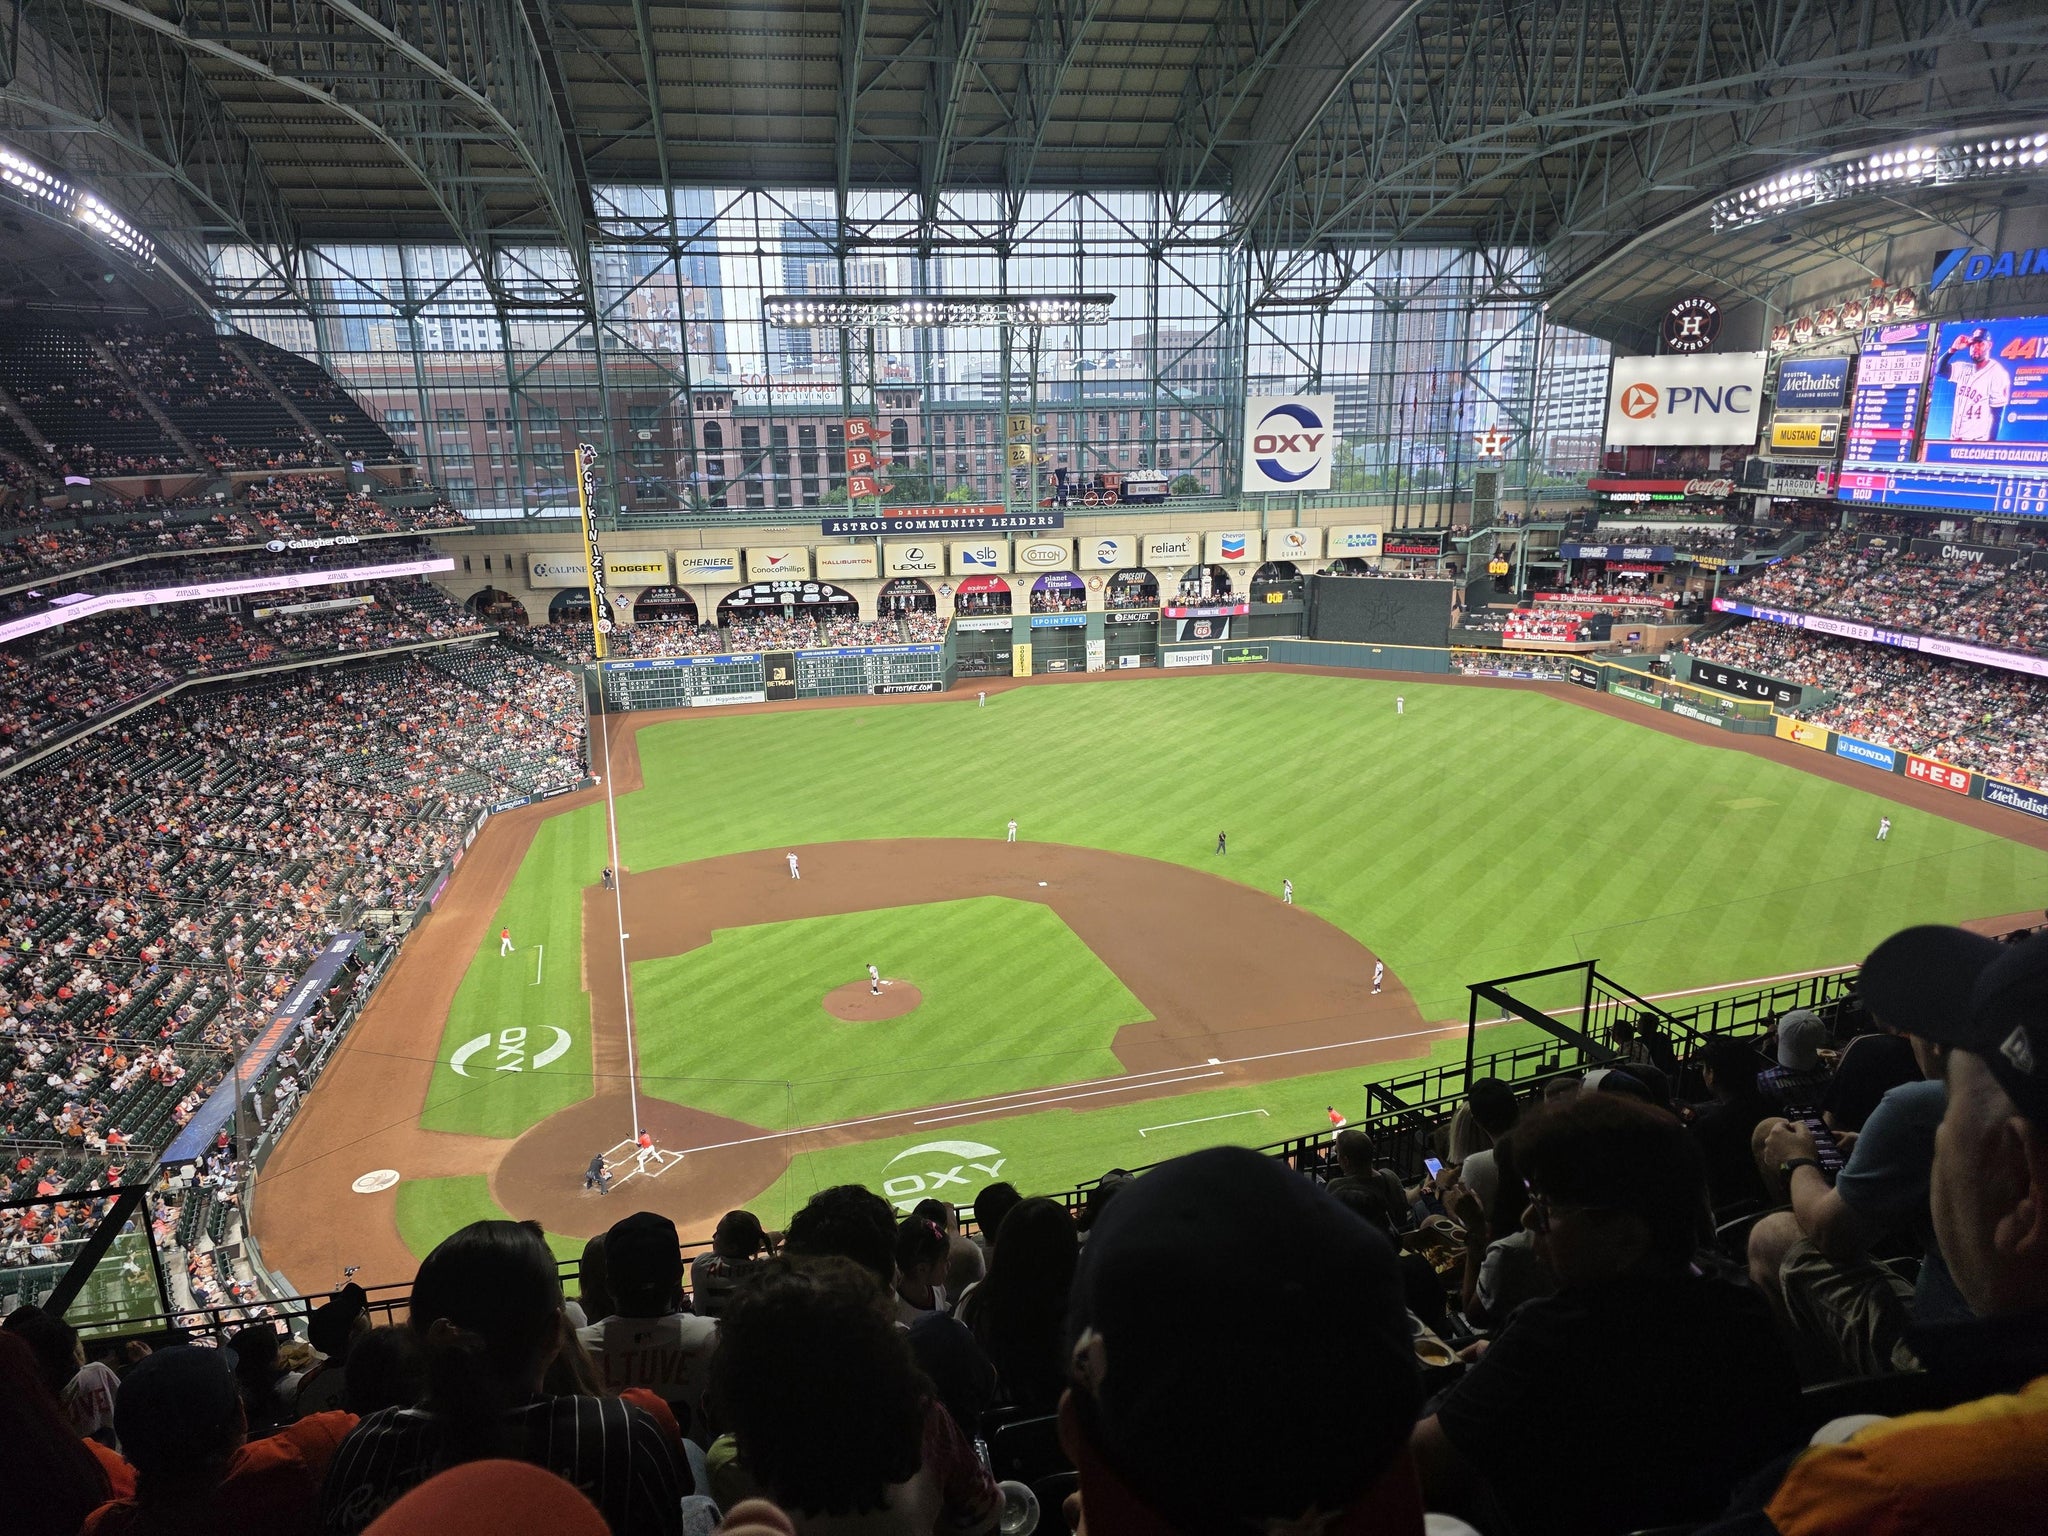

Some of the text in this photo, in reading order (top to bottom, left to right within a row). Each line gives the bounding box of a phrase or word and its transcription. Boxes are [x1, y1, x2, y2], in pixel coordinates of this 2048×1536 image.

[1671, 299, 1718, 316] HOUSTON
[1816, 309, 1835, 324] 25
[1680, 316, 1703, 336] H
[1794, 317, 1810, 333] 40
[1771, 326, 1787, 340] 32
[1669, 336, 1711, 350] ASTROS
[2000, 337, 2038, 359] 44
[739, 374, 838, 394] 500 CRAWFORD
[1782, 374, 1841, 391] Methodist
[1666, 385, 1752, 414] PNC
[1966, 405, 1982, 419] 44
[850, 422, 865, 435] 05
[1012, 420, 1026, 431] 17
[1780, 430, 1836, 442] MUSTANG CAT
[1253, 433, 1325, 454] OXY
[1478, 433, 1502, 456] H
[852, 453, 866, 464] 19
[1012, 450, 1026, 460] 22
[1951, 448, 2041, 461] WELCOME TO DAIKIN
[853, 479, 867, 491] 21
[1777, 480, 1820, 493] HARGROVE
[1856, 477, 2046, 498] CLE 0 0 2 0
[1610, 493, 1651, 501] HORNITOS
[1853, 489, 2044, 512] HOU 0 0 0
[898, 508, 945, 516] DAIKIN
[832, 516, 1054, 532] ASTROS COMMUNITY LEADERS
[288, 535, 359, 549] Gallagher Club
[583, 471, 607, 618] CHIKIN IZ FAIR
[1347, 533, 1377, 547] LNG
[976, 546, 997, 560] slb
[1151, 542, 1188, 554] reliant
[1385, 543, 1440, 555] Budweiser
[1942, 545, 1984, 563] Chevy
[682, 557, 734, 567] CHENIERE
[1027, 550, 1061, 561] COTTON
[1691, 555, 1726, 566] PLUCKERS
[548, 566, 587, 574] CALPINE
[610, 564, 662, 573] DOGGETT
[751, 565, 806, 573] ConocoPhillips
[893, 563, 936, 571] LEXUS
[1605, 561, 1665, 572] Budweiser
[327, 572, 349, 580] ZIPAIR
[1045, 575, 1067, 583] planet
[1118, 572, 1147, 581] SPACE CITY
[175, 589, 200, 597] ZIPAIR
[1266, 593, 1283, 603] 0:08
[1560, 594, 1604, 602] Budweiser
[1629, 596, 1665, 606] Budweiser
[1034, 616, 1084, 625] 1POINTFIVE
[1122, 613, 1151, 622] EMCJET
[1197, 627, 1209, 635] 66
[1818, 620, 1869, 637] ezee FIBER
[1524, 633, 1567, 641] Budweiser
[1175, 654, 1211, 664] Insperity
[883, 684, 933, 693] NITTOTIRE.COM
[1699, 668, 1792, 702] LEXUS
[1673, 703, 1687, 714] SPACE
[1686, 706, 1697, 717] CITY
[1721, 700, 1734, 708] 370
[1849, 744, 1893, 765] HONDA
[1989, 782, 2015, 793] HOUSTON
[1987, 789, 2048, 815] Methodist
[256, 1017, 294, 1050] DAIKIN
[496, 1026, 527, 1072] OXY
[883, 1158, 1007, 1197] OXY
[602, 1348, 697, 1389] LTUVE
